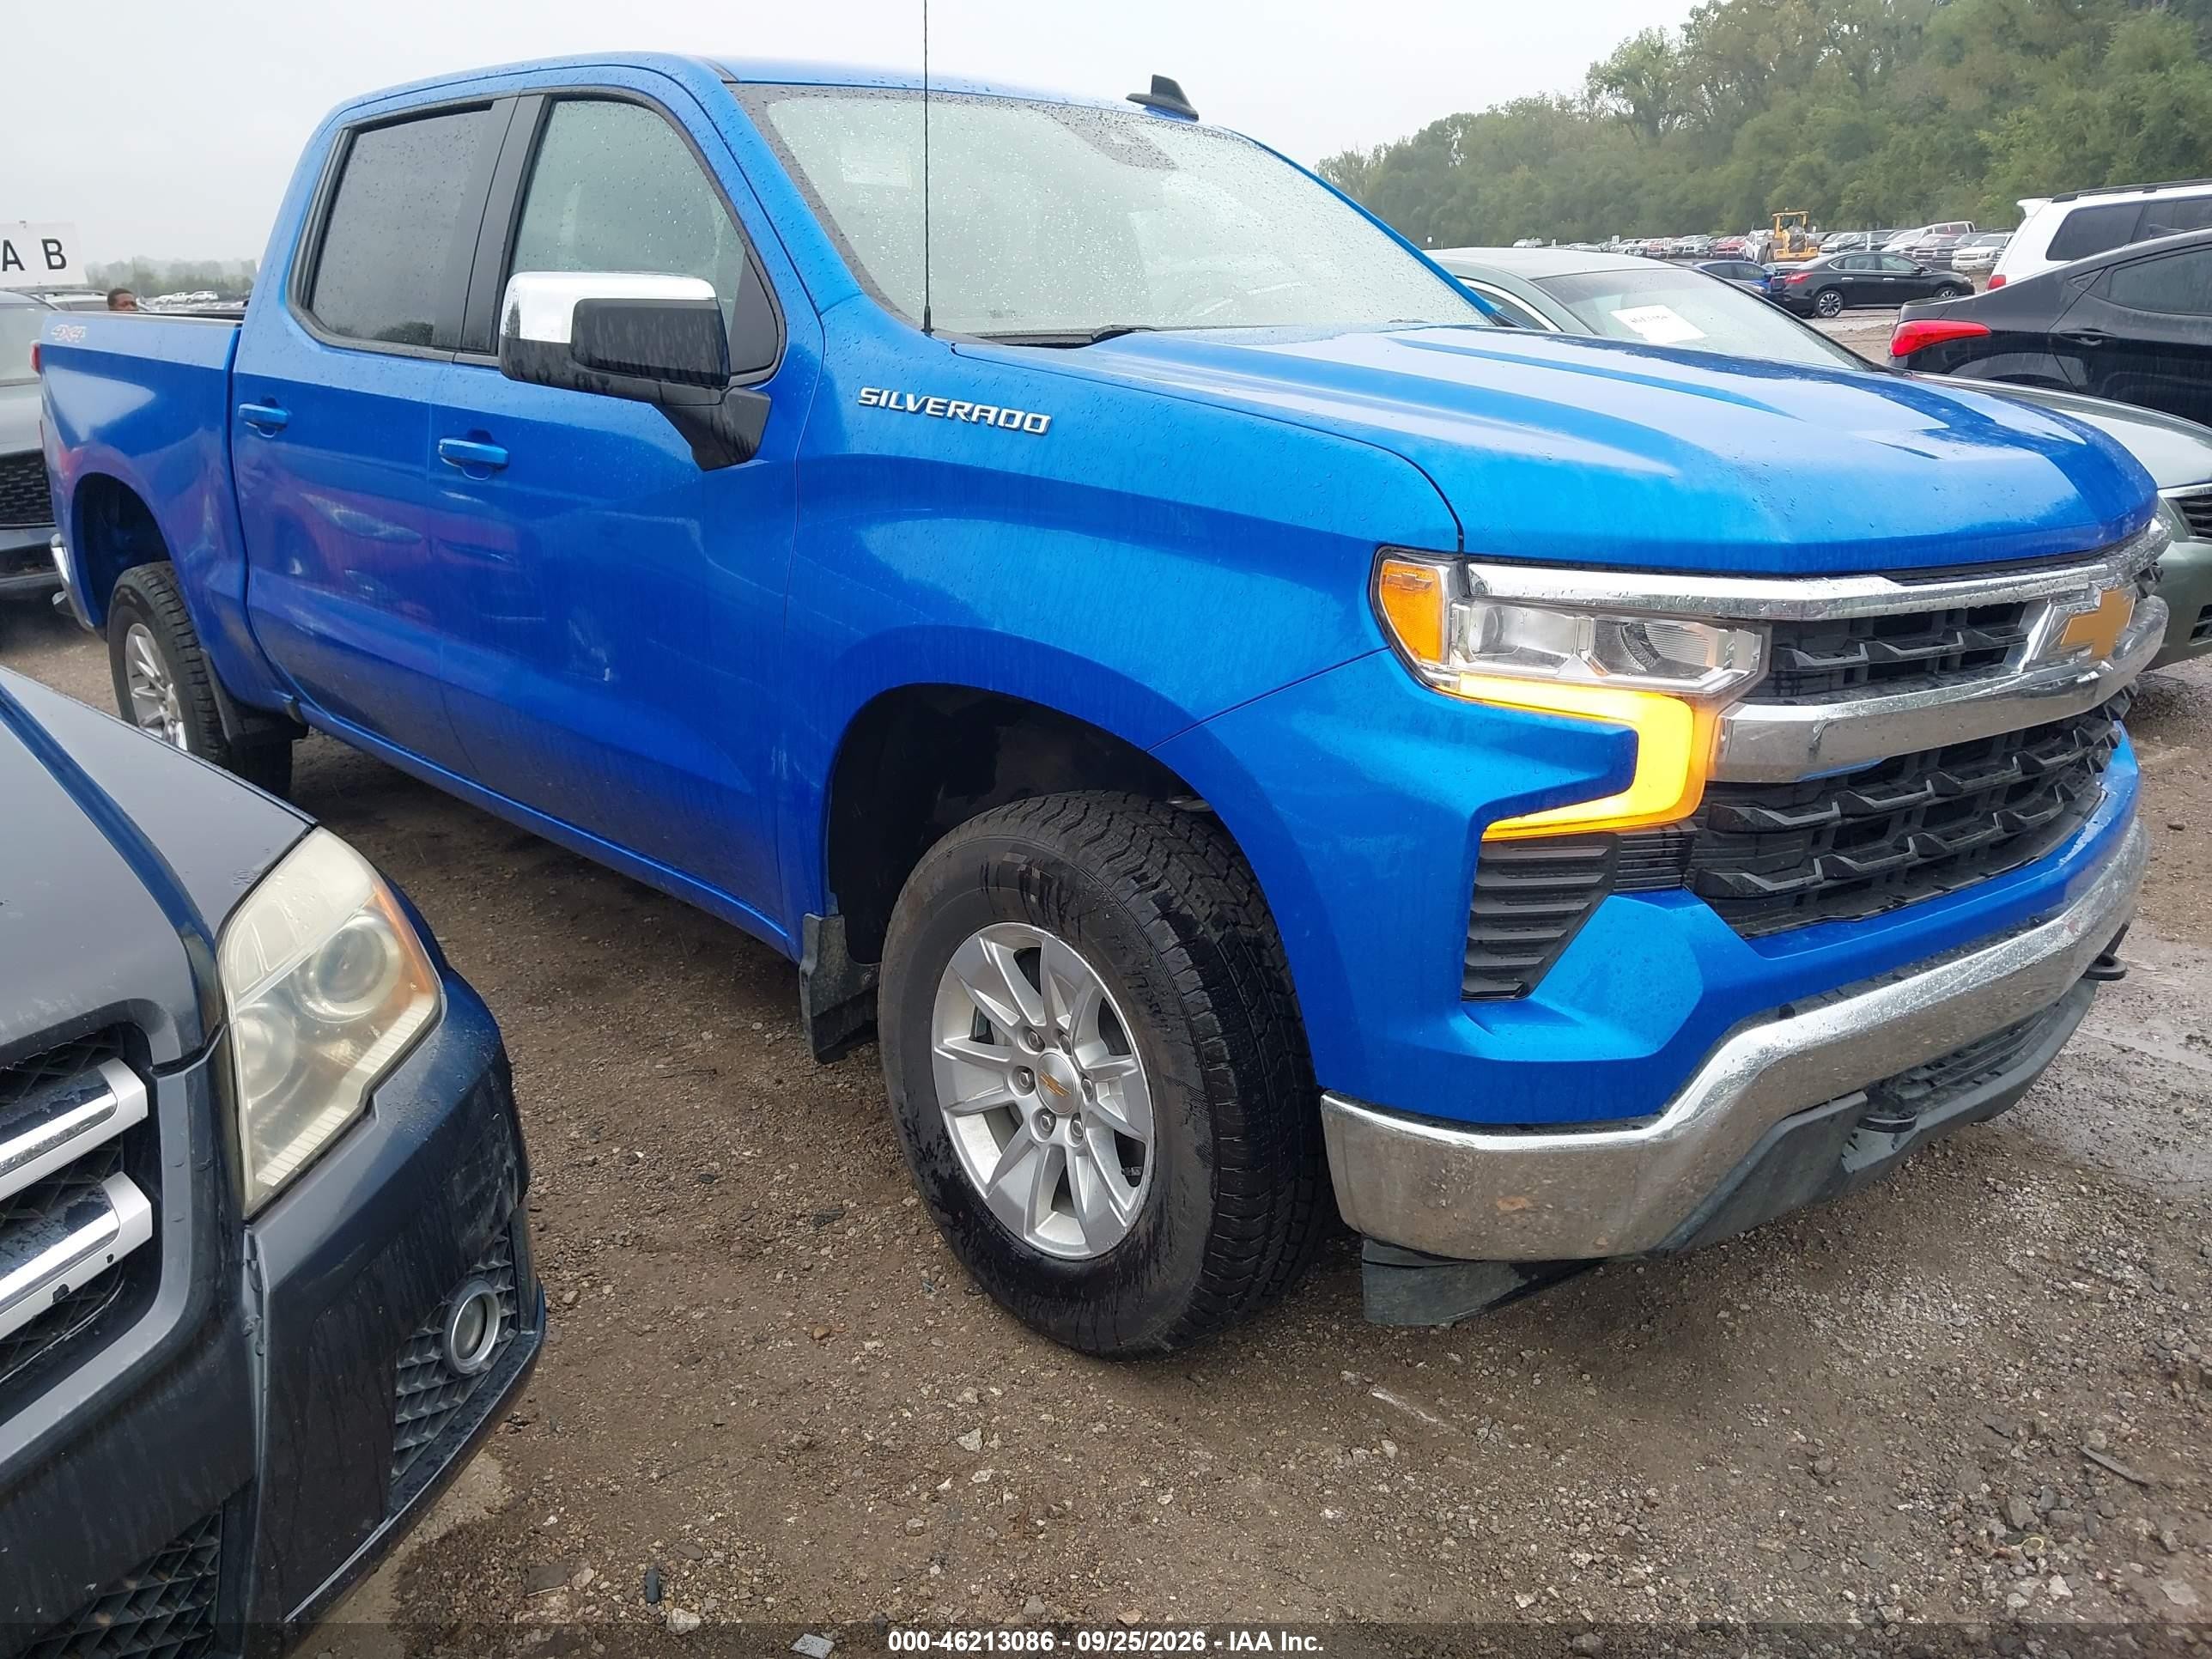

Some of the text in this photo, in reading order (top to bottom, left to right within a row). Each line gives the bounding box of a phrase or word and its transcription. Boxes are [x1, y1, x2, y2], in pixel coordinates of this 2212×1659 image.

[2, 238, 67, 271] A B
[858, 386, 1053, 435] SILVERADO
